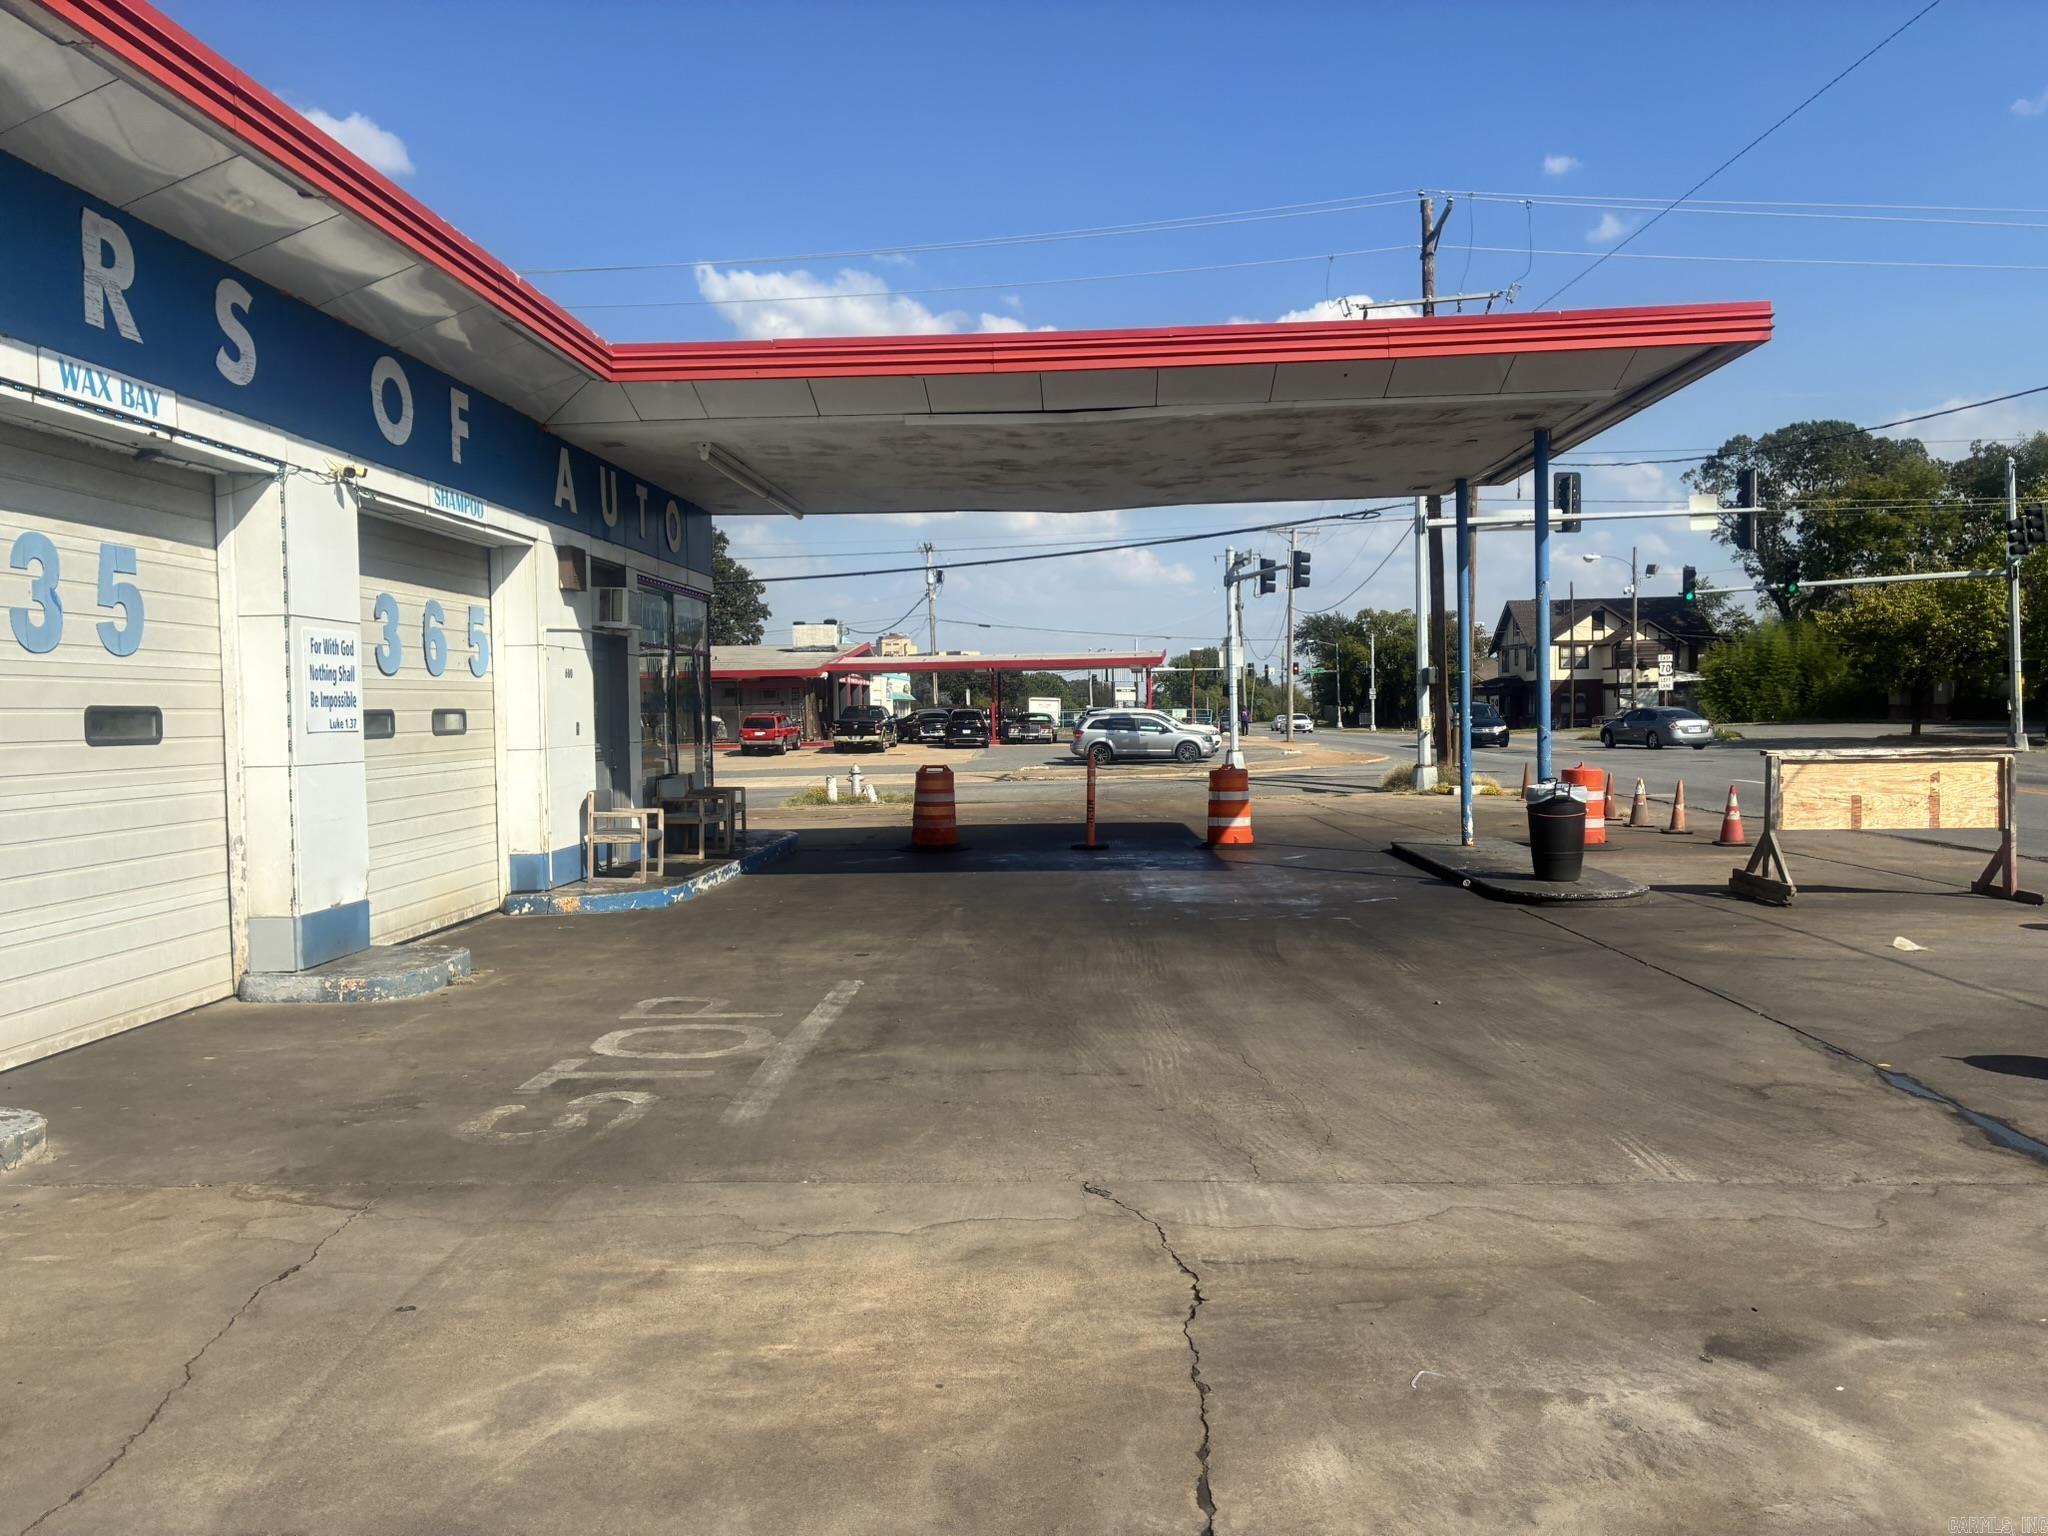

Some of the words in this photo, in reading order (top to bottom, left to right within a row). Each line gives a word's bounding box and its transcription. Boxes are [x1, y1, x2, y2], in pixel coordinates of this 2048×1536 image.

[58, 355, 113, 403] WAX
[120, 378, 162, 418] BAY
[81, 206, 257, 386] RS
[370, 355, 470, 465] OF
[554, 446, 682, 554] AUTO
[433, 485, 485, 519] SHAMPOO
[310, 637, 322, 654] For
[323, 638, 340, 656] With
[340, 639, 355, 657] God
[374, 592, 490, 678] 365
[309, 663, 337, 686] Nothing
[338, 665, 356, 682] Shall
[1660, 664, 1671, 673] 70
[310, 691, 319, 708] Be
[320, 691, 357, 712] Impossible
[329, 718, 344, 730] Luke
[452, 995, 784, 1145] STOP
